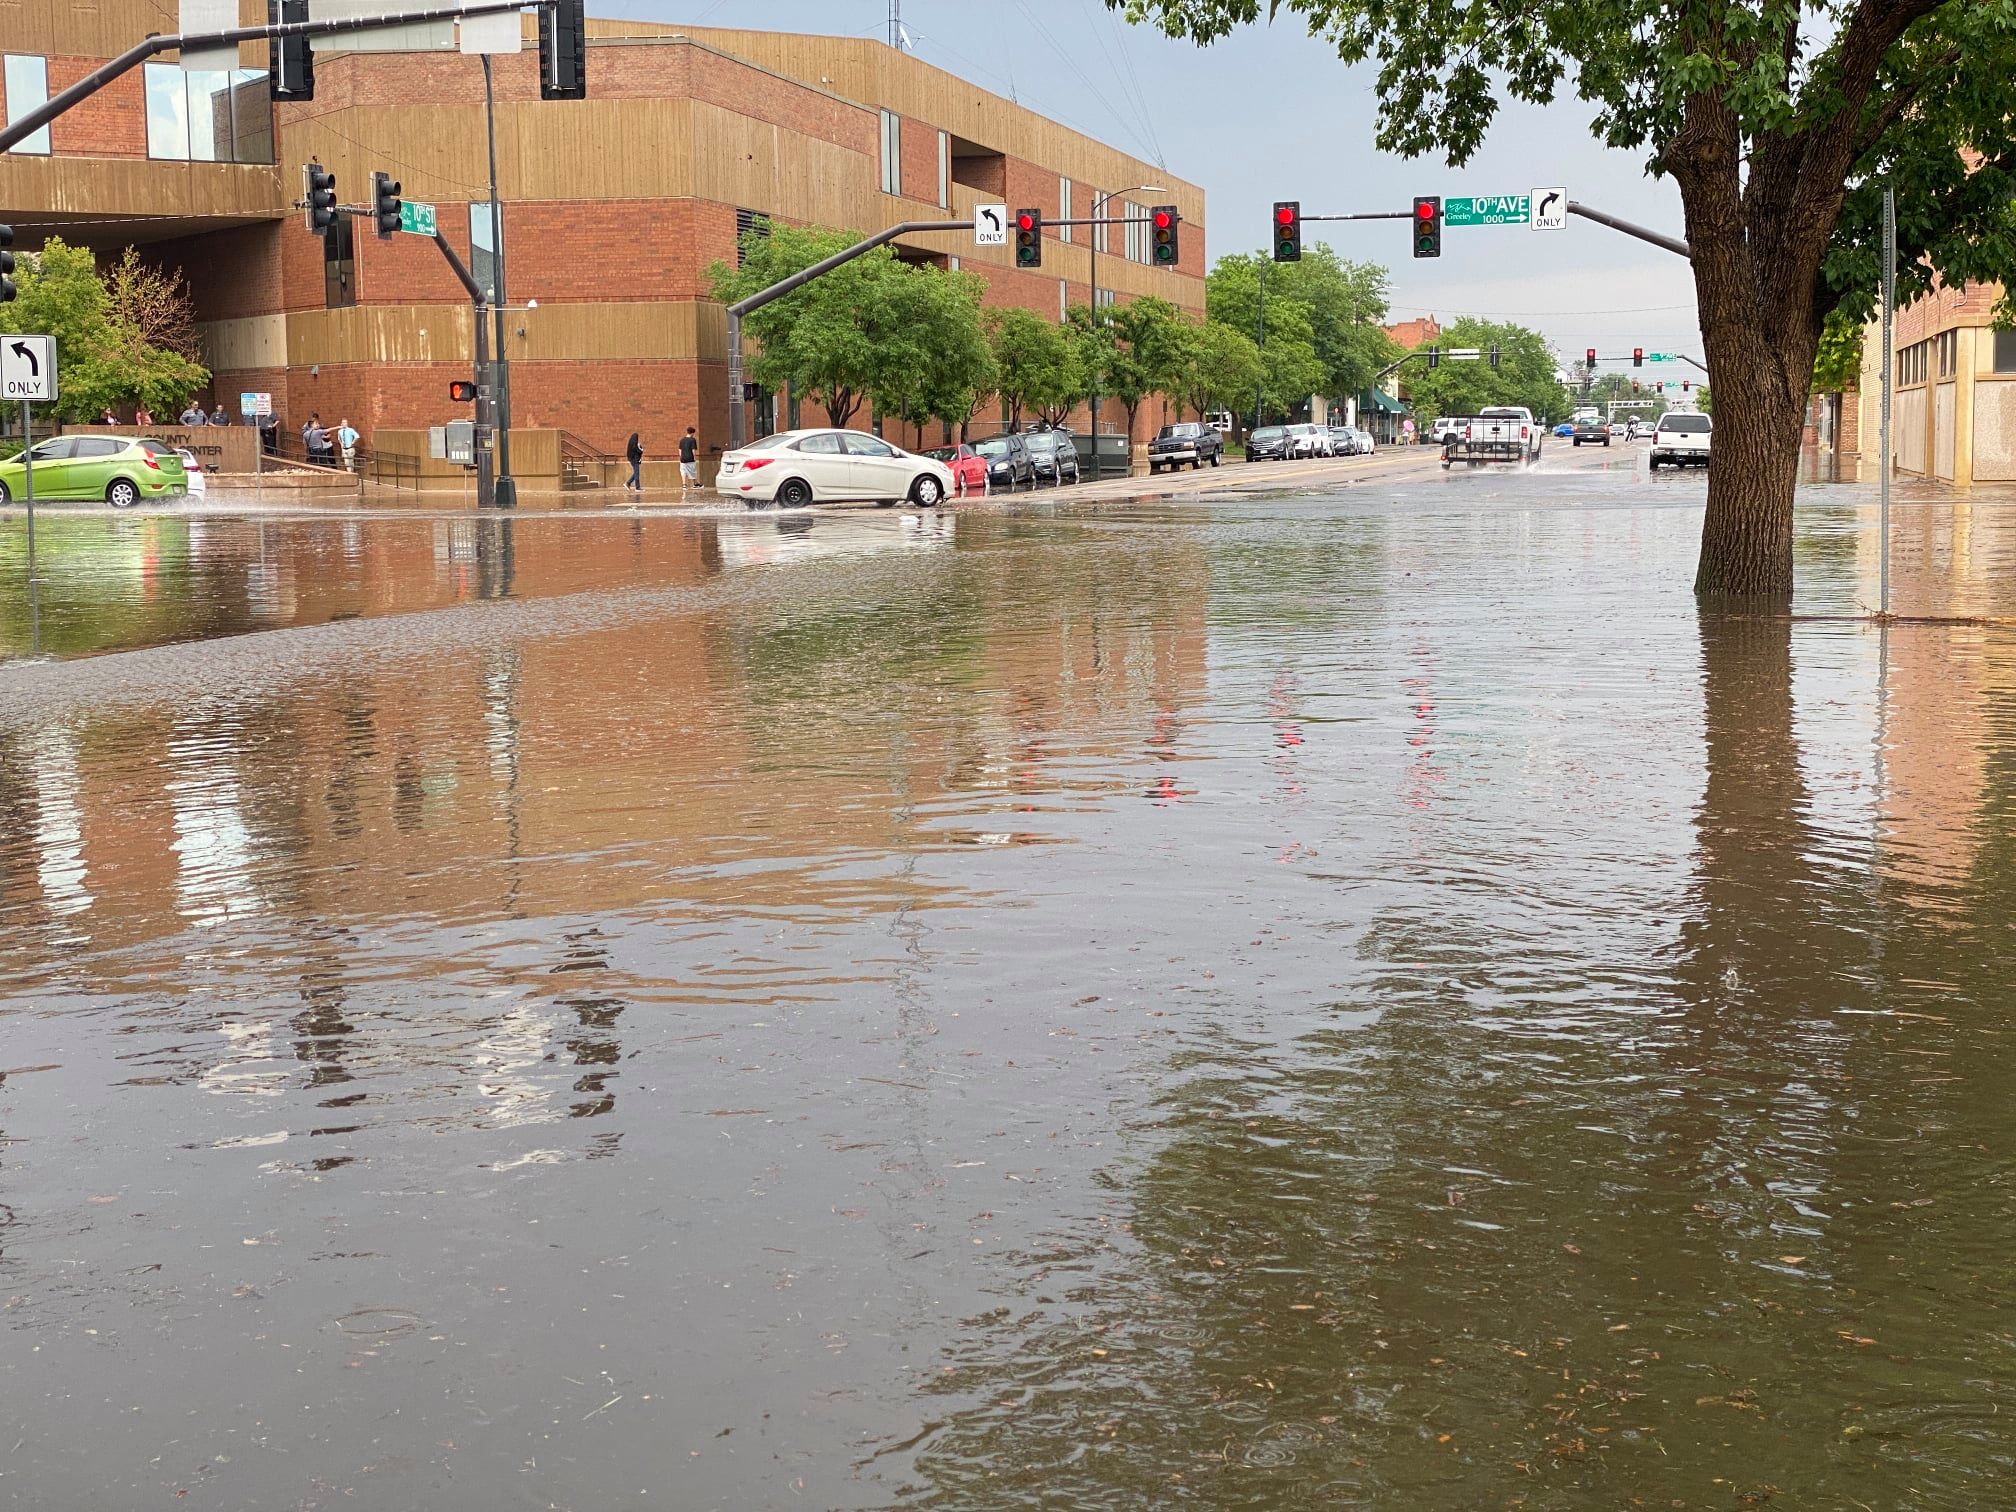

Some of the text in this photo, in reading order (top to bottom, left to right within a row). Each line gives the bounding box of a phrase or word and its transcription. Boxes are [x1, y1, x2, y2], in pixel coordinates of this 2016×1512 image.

[1471, 197, 1529, 214] 10TH AVE
[426, 206, 434, 224] ST
[1446, 212, 1471, 222] Greeley
[1483, 214, 1505, 224] 1000
[1536, 218, 1561, 227] ONLY
[979, 233, 1003, 242] ONLY
[8, 381, 41, 394] ONLY
[179, 445, 222, 456] ENTER
